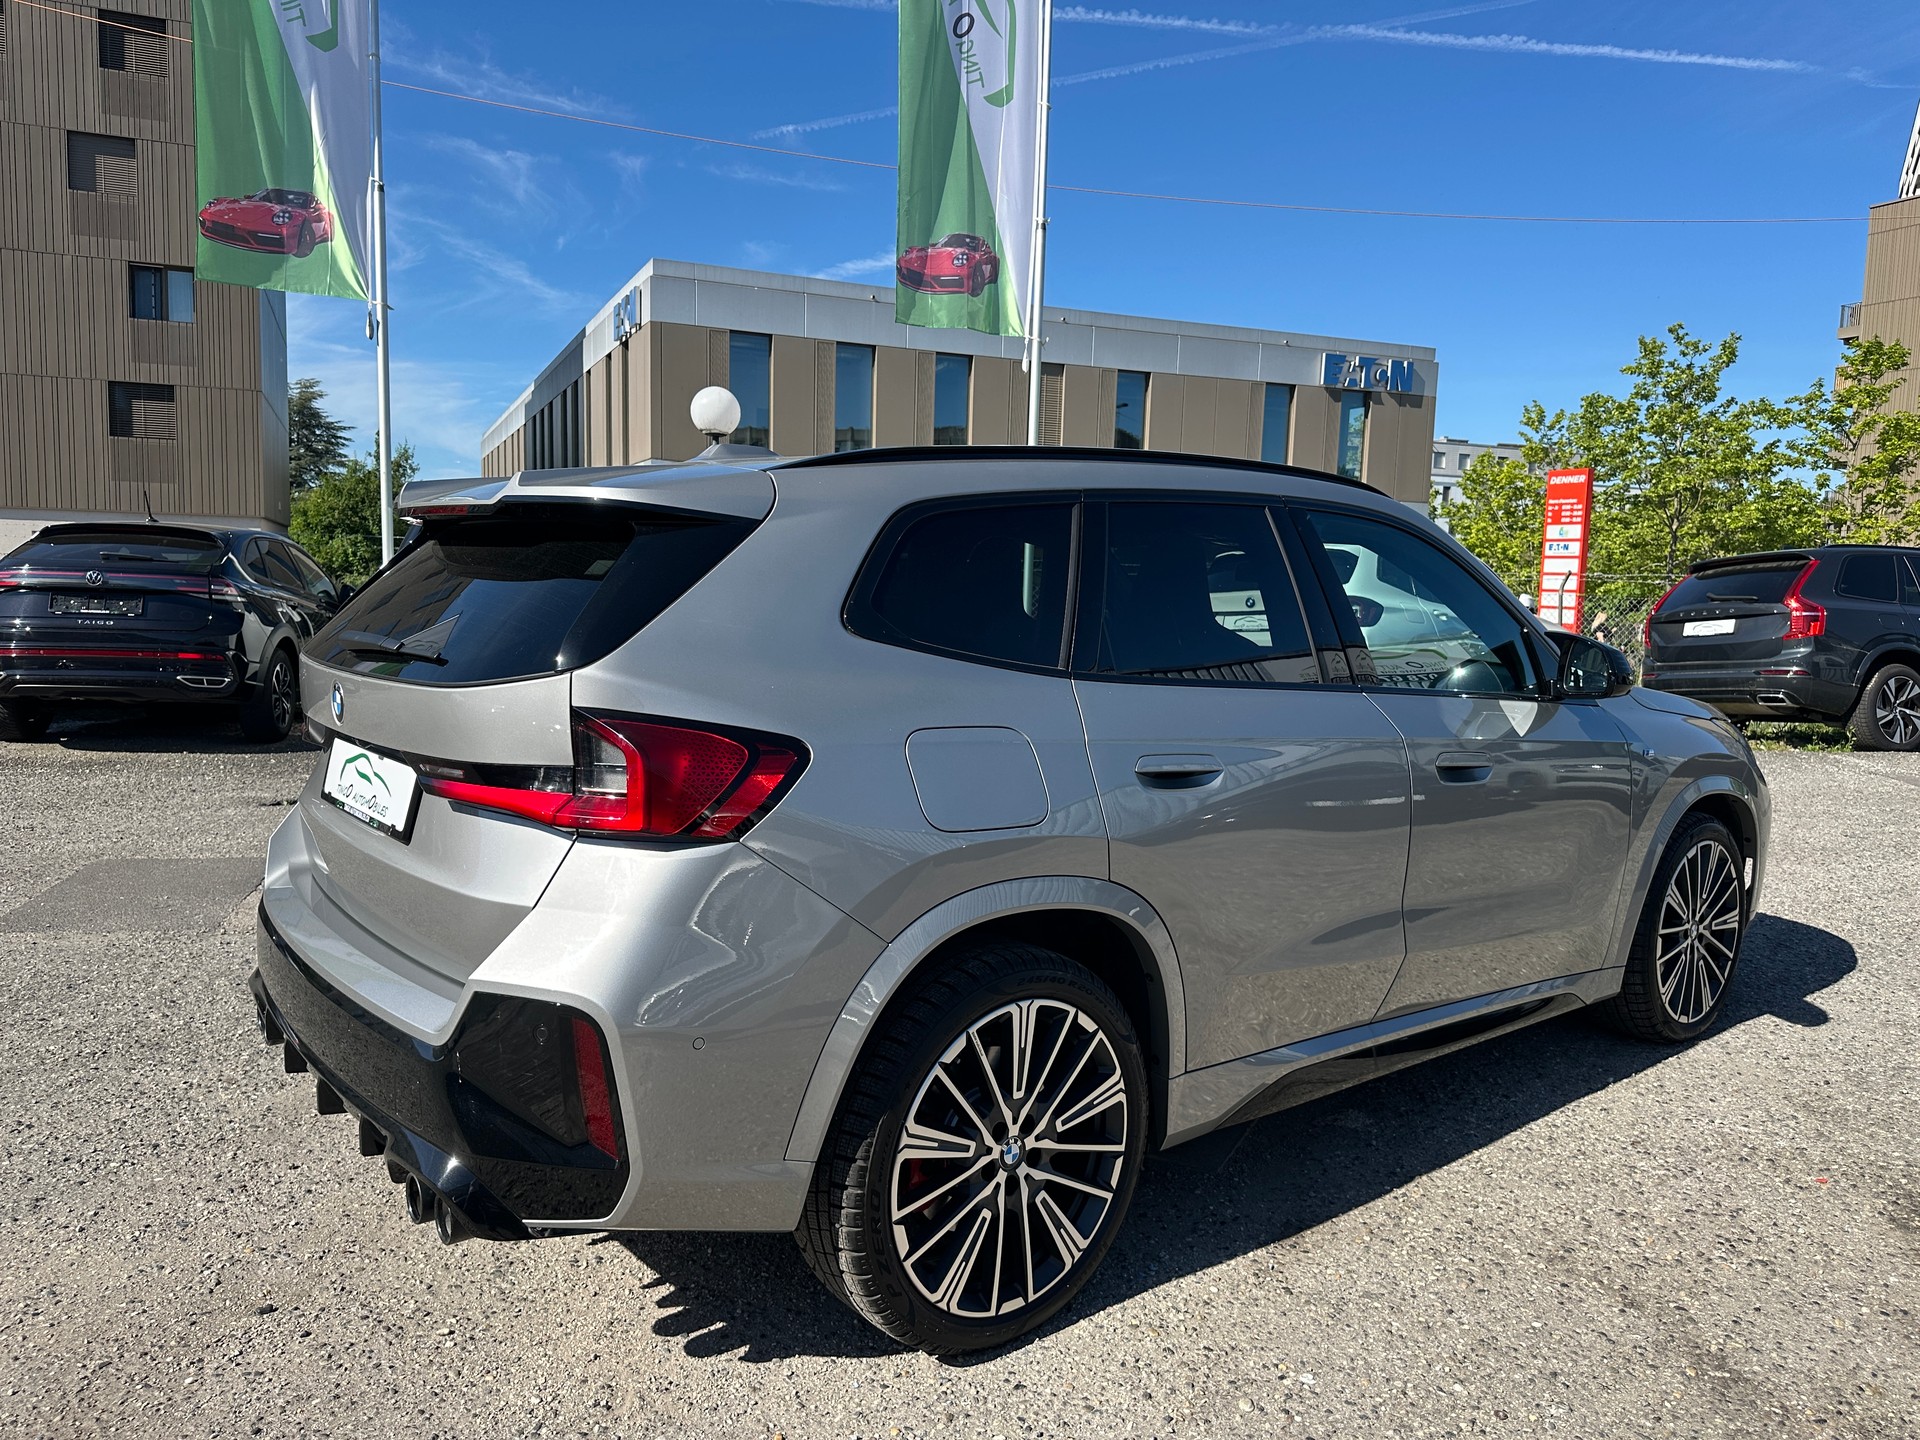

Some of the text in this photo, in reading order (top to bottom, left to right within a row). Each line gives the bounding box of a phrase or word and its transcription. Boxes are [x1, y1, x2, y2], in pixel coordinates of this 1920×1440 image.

[1320, 352, 1414, 392] EATON
[1550, 475, 1586, 485] DENNER
[870, 1188, 892, 1277] ZERO
